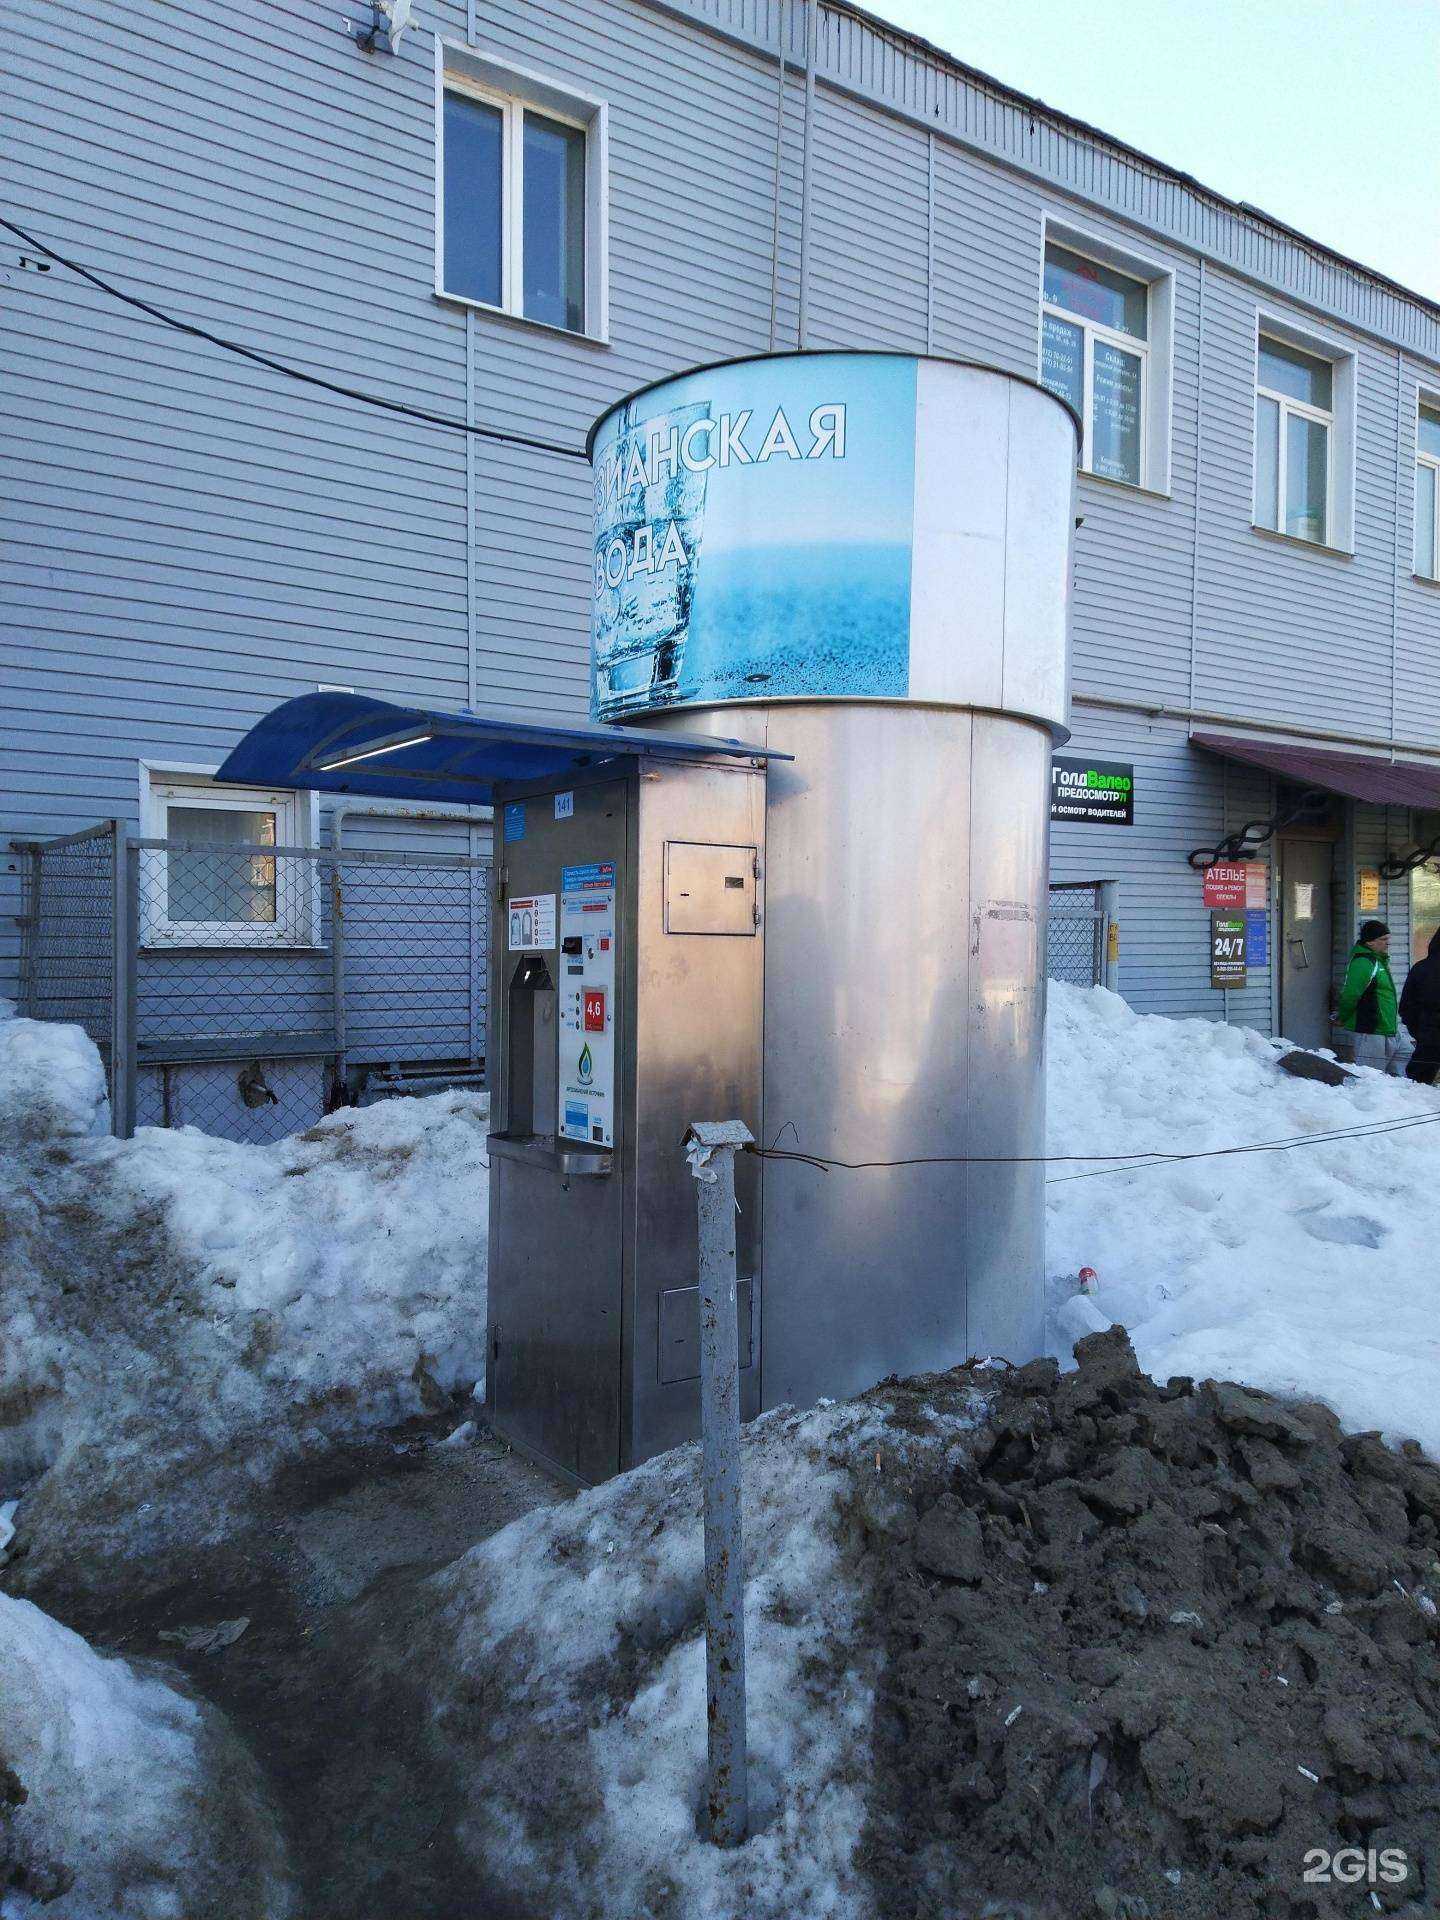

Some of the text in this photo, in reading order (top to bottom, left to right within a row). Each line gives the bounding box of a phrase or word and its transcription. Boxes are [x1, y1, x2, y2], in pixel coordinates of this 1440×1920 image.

[596, 518, 690, 599] ВОДА
[1052, 766, 1131, 791] ГолдВалео
[1058, 805, 1087, 816] ОСМОТР
[1087, 808, 1127, 818] ВОДИТЕЛЕЙ
[1206, 868, 1246, 881] АТЕЛЬЕ
[1214, 937, 1244, 959] 24/7
